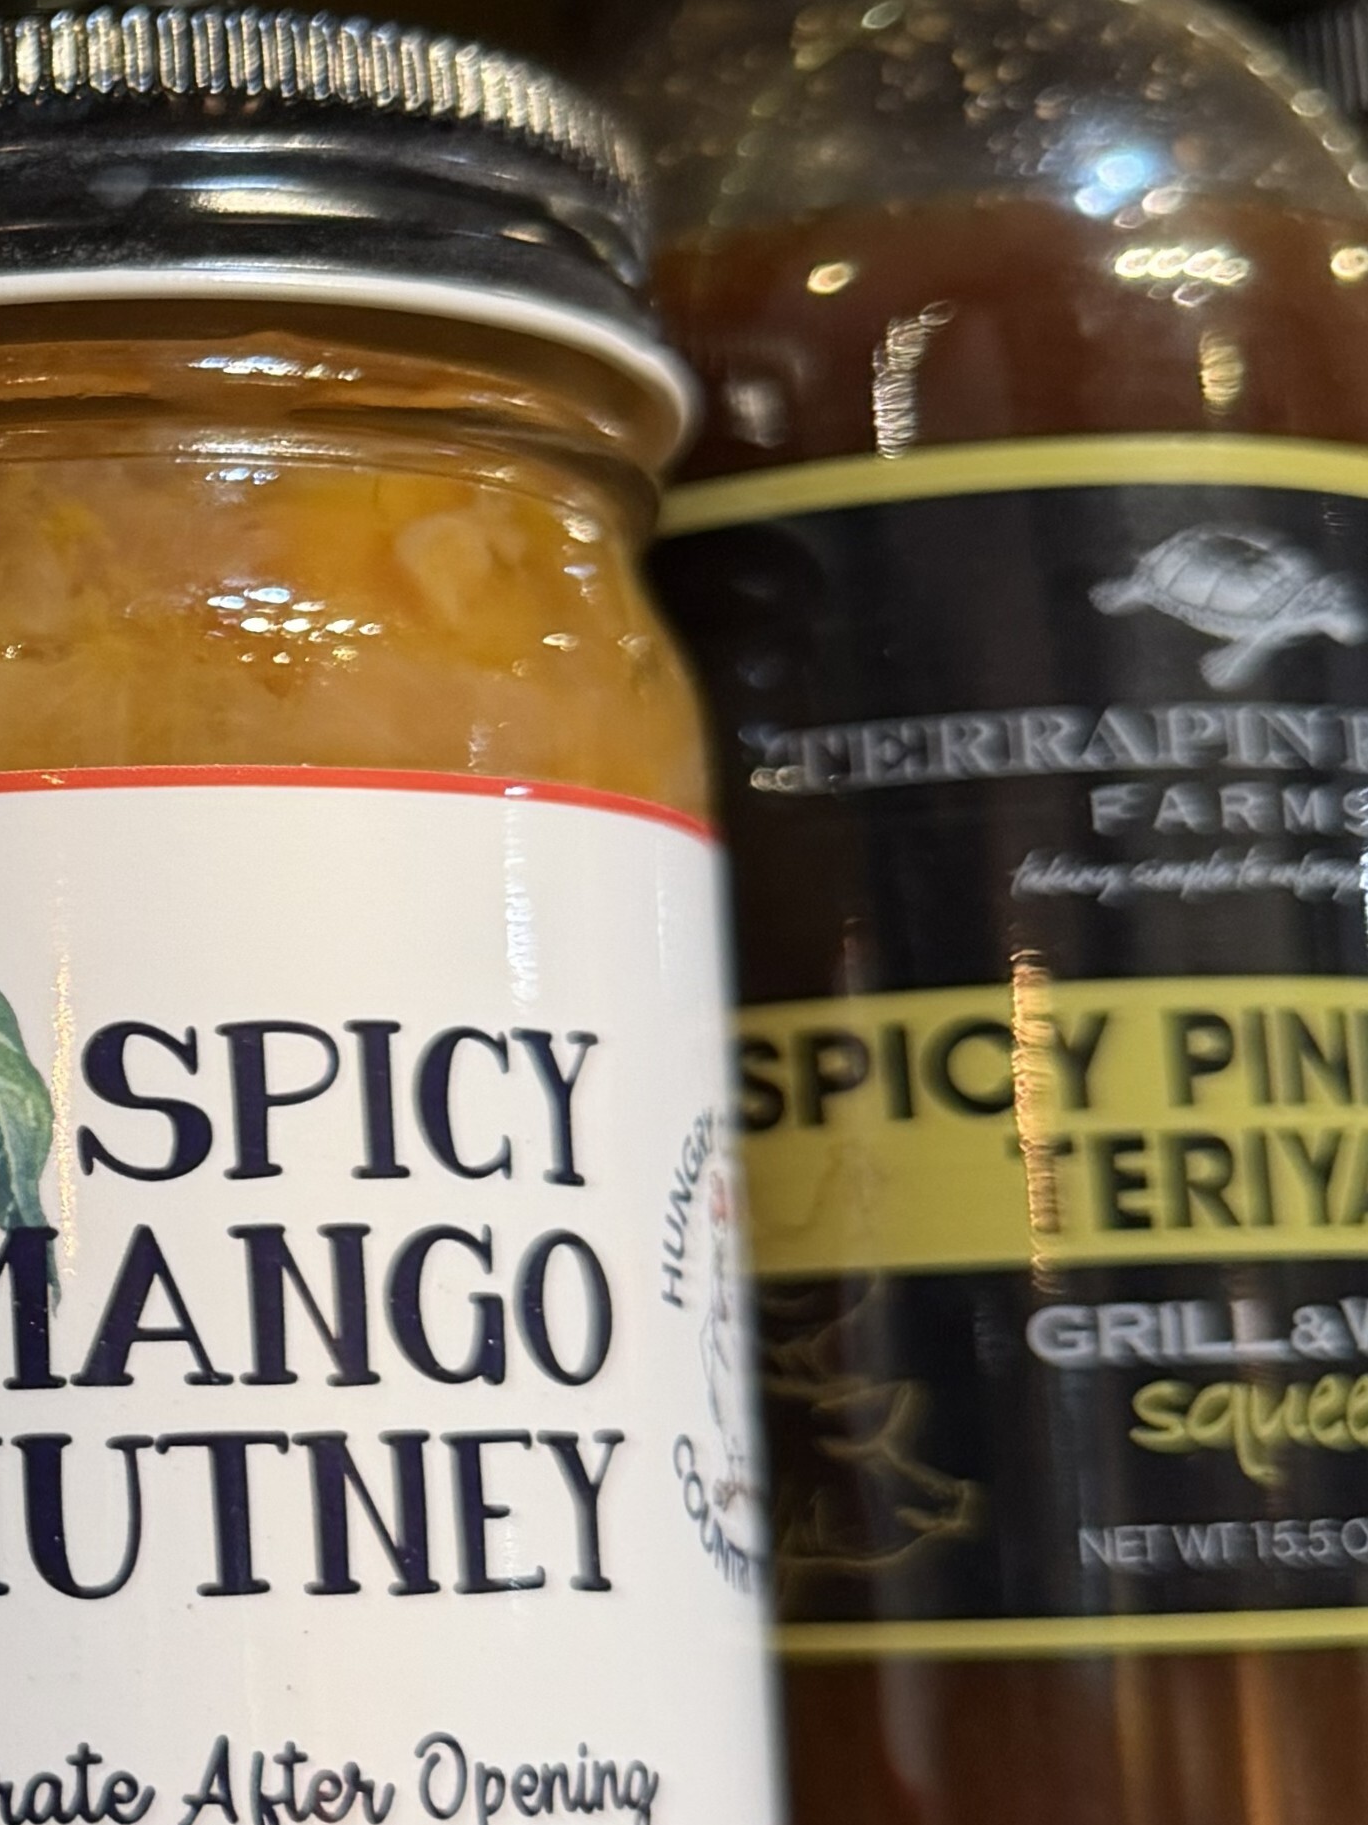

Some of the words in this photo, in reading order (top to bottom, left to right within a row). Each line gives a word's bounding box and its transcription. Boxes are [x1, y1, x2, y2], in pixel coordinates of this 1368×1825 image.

[77, 1019, 598, 1186] SPICY
[730, 1006, 1109, 1133] SPICY
[1165, 1008, 1368, 1108] PIN
[1078, 1524, 1167, 1568] NET
[1171, 1522, 1248, 1568] WT
